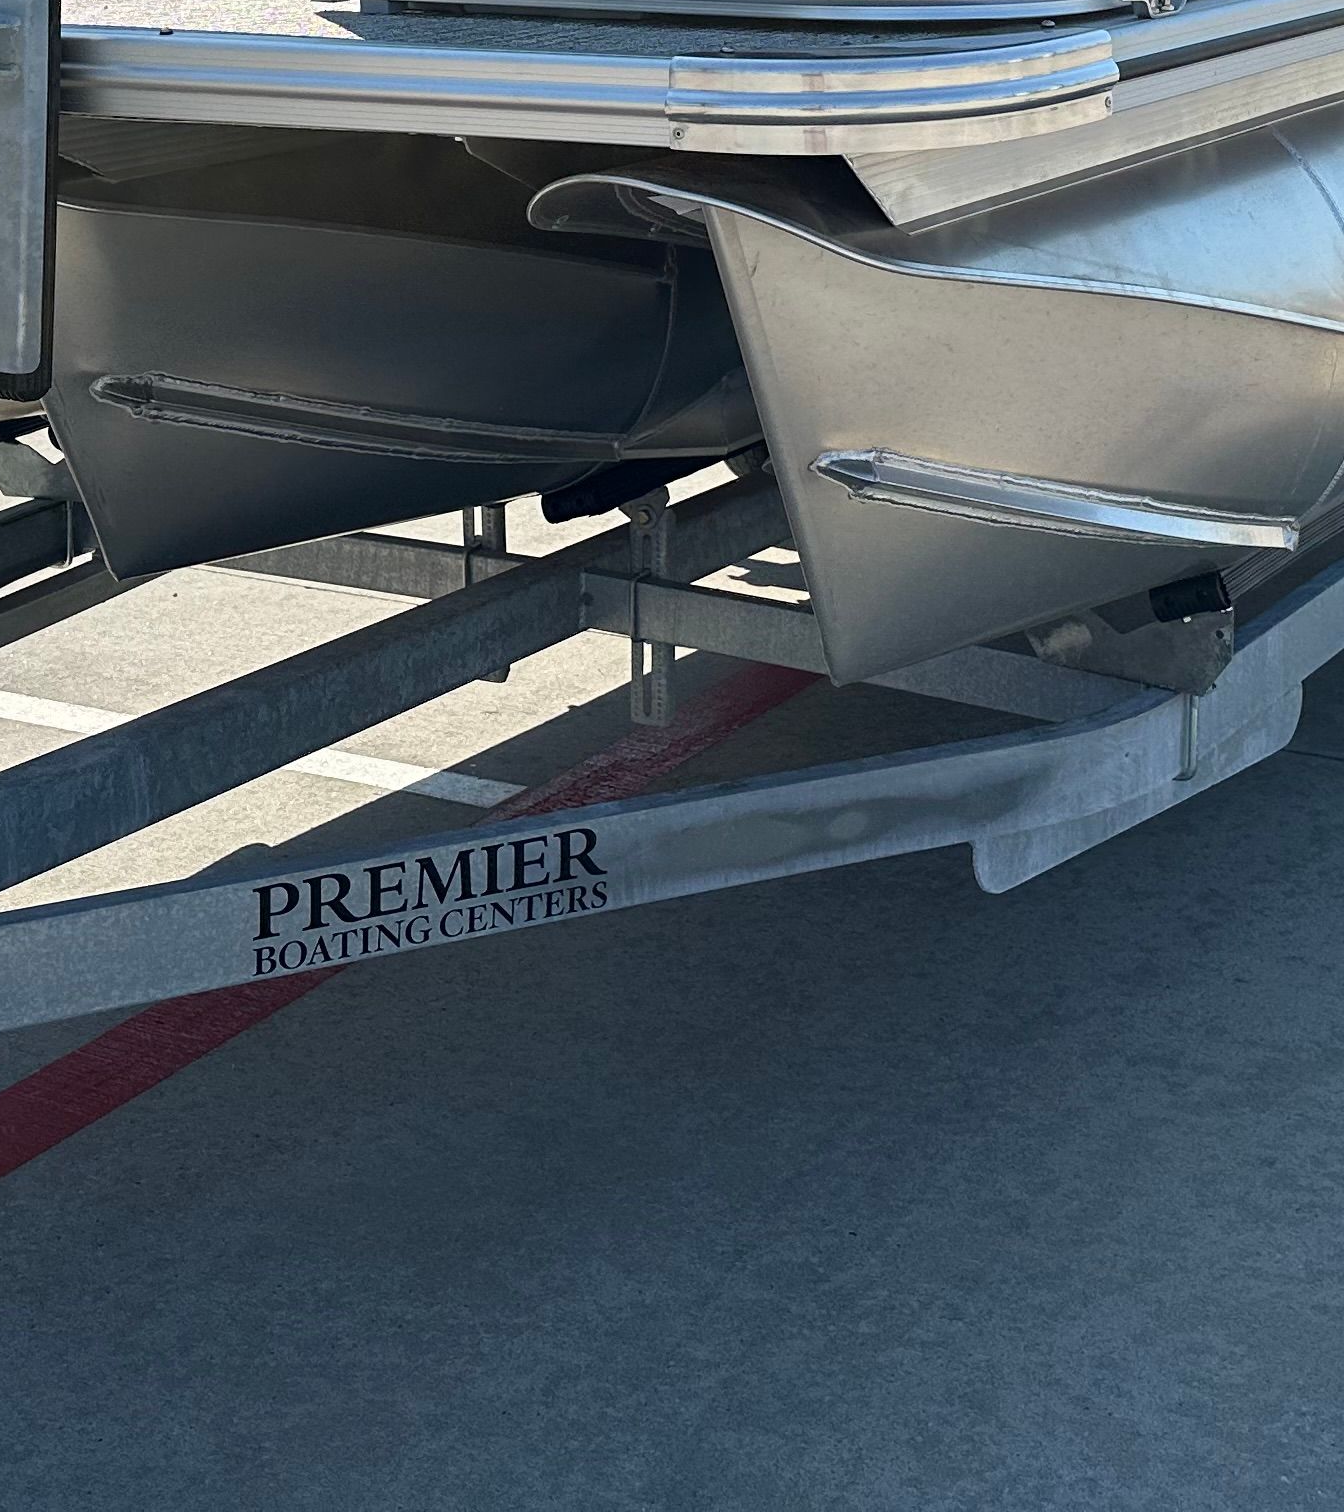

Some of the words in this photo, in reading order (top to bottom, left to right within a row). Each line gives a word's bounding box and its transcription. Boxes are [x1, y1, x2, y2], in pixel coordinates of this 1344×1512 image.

[252, 827, 608, 942] PREMIER
[252, 914, 433, 977] BOATING
[439, 880, 608, 939] CENTERS
